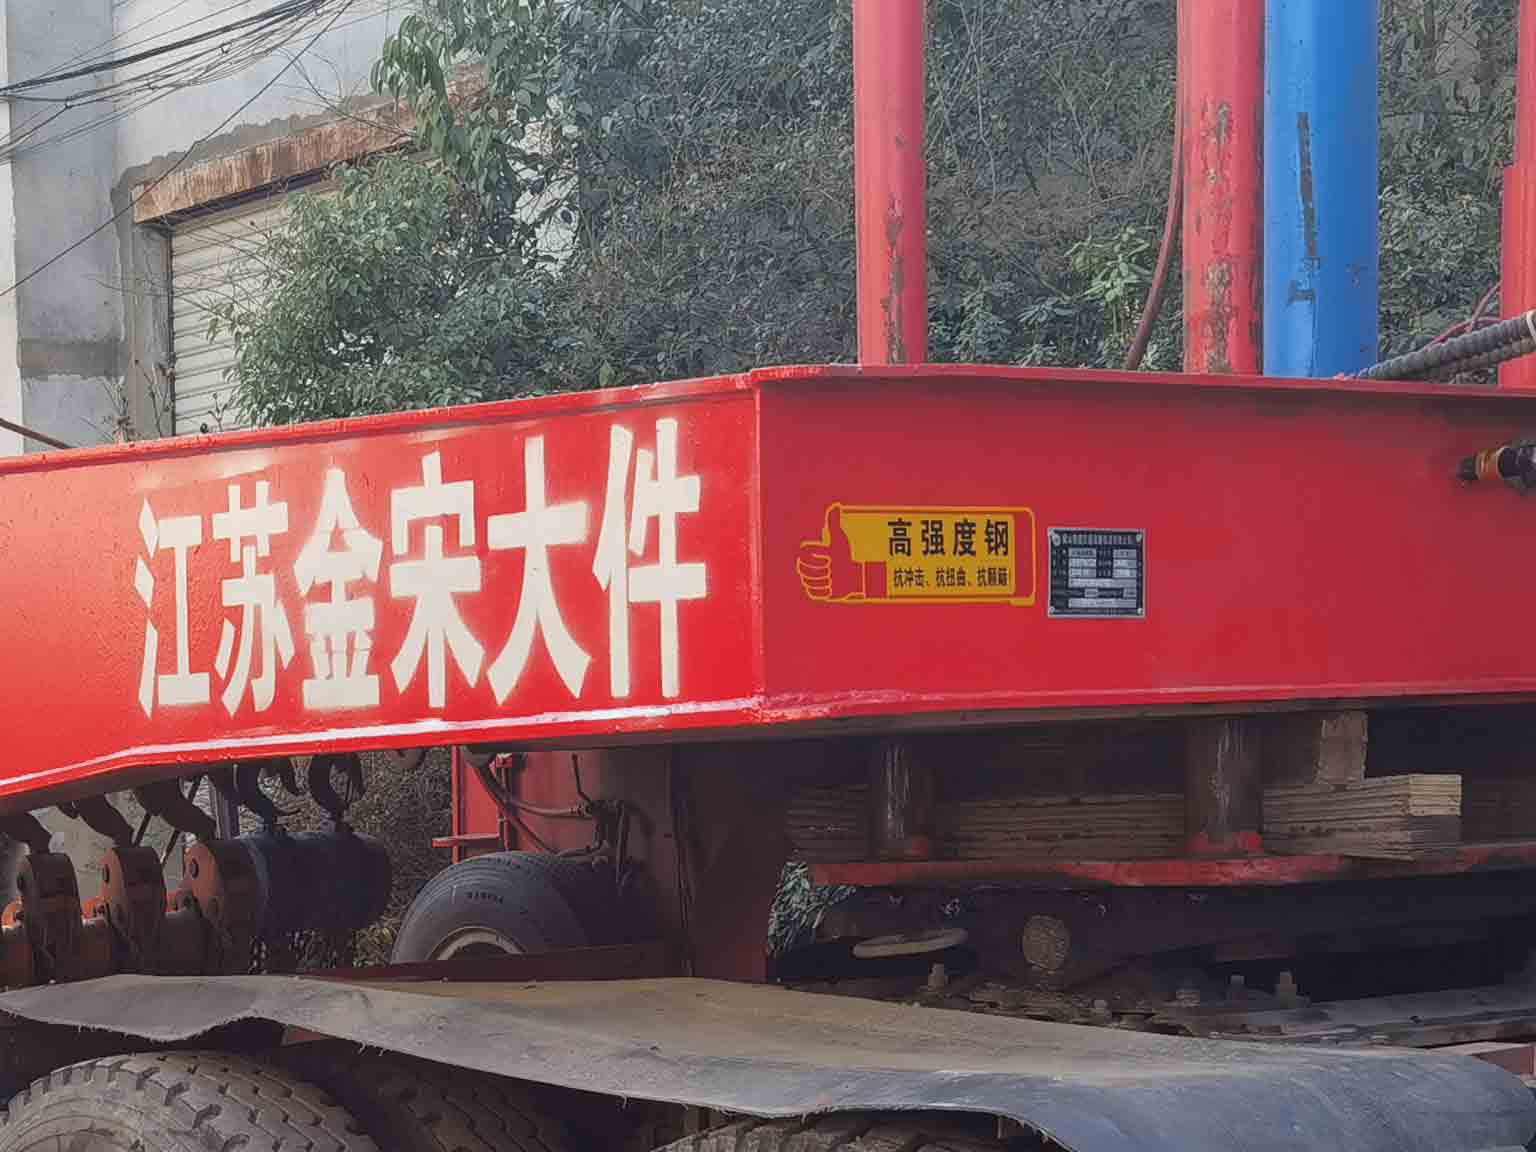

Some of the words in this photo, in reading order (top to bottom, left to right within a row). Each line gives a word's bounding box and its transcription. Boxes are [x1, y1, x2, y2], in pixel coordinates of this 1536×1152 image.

[134, 418, 707, 718] 江苏金宋大件
[887, 517, 1009, 557] 高强度钢
